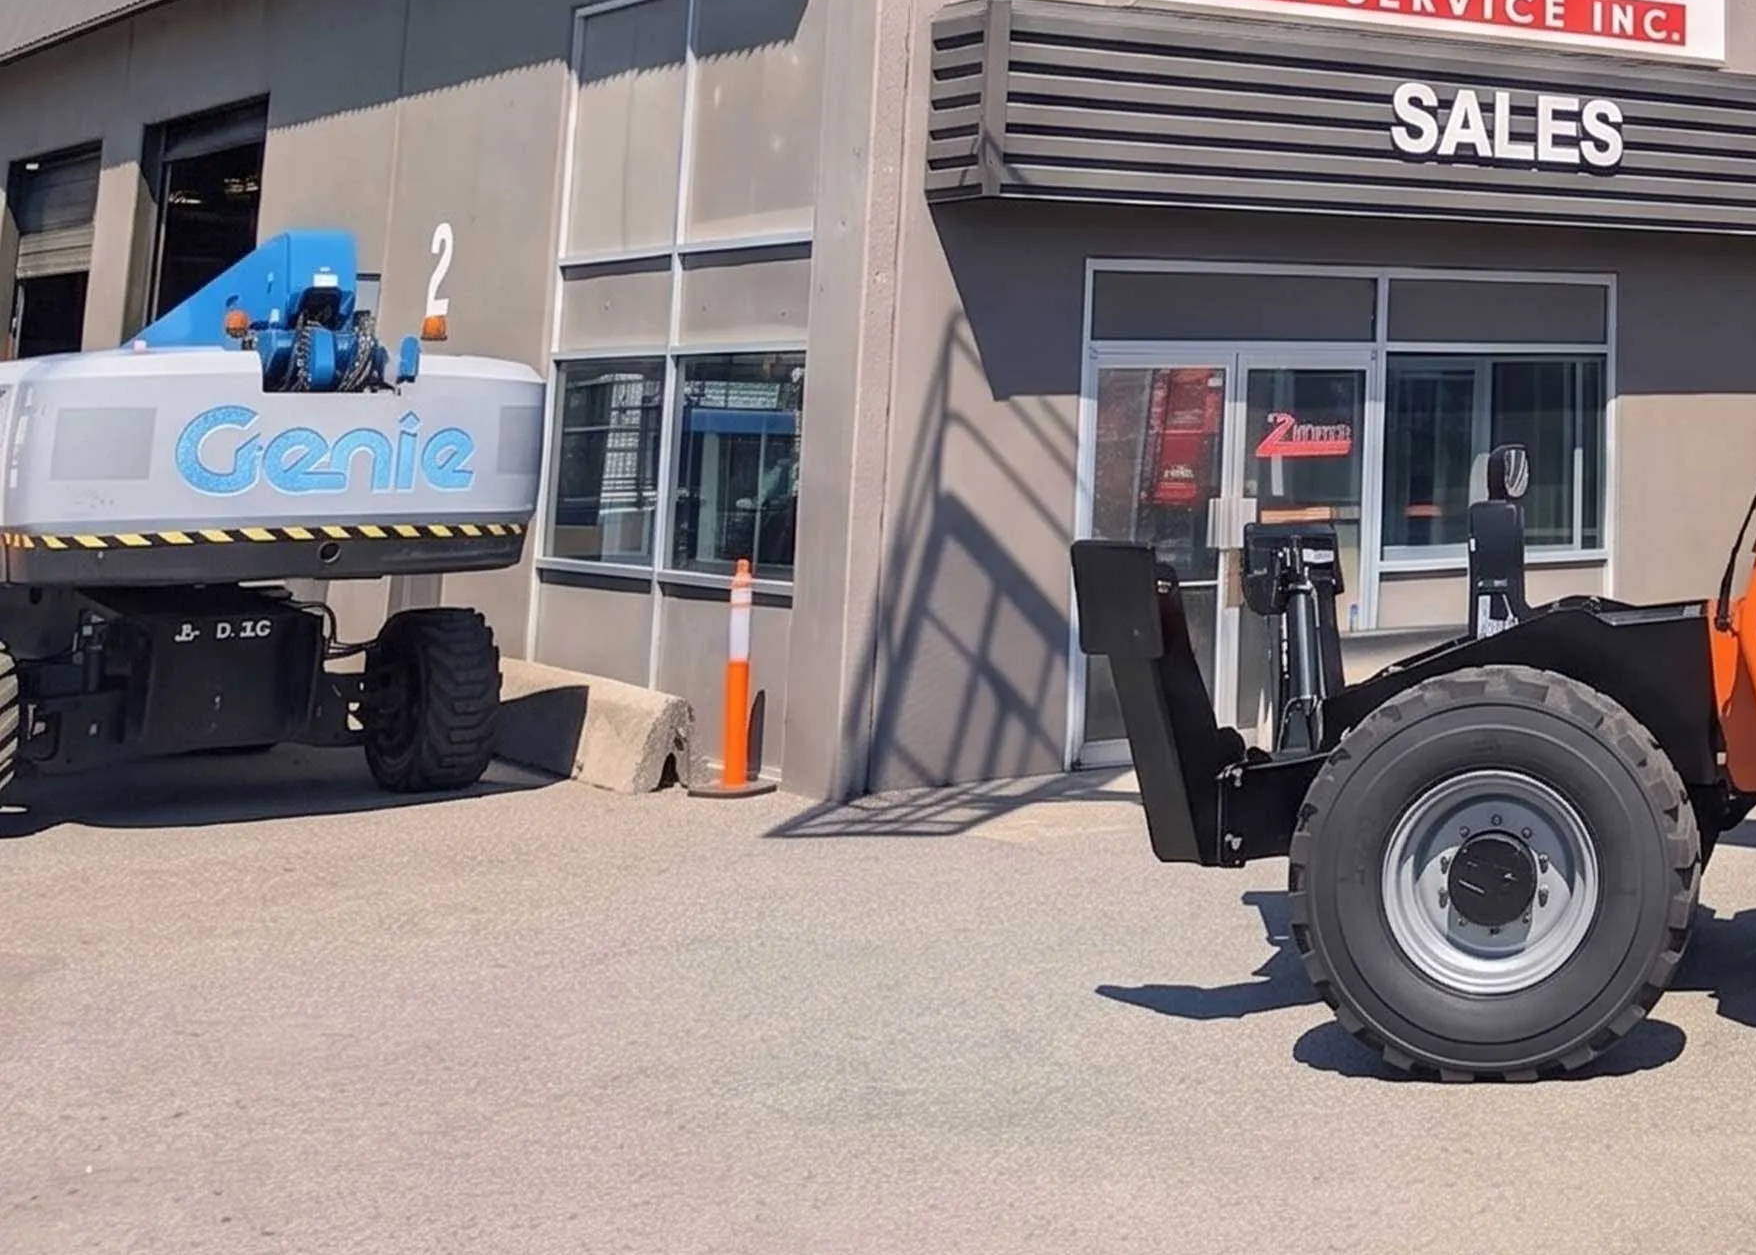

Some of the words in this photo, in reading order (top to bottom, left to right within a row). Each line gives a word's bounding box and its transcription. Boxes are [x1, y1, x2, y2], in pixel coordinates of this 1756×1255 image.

[1593, 2, 1681, 42] INC.
[1390, 82, 1624, 168] SALES
[425, 222, 453, 317] 2
[175, 404, 476, 496] Genie
